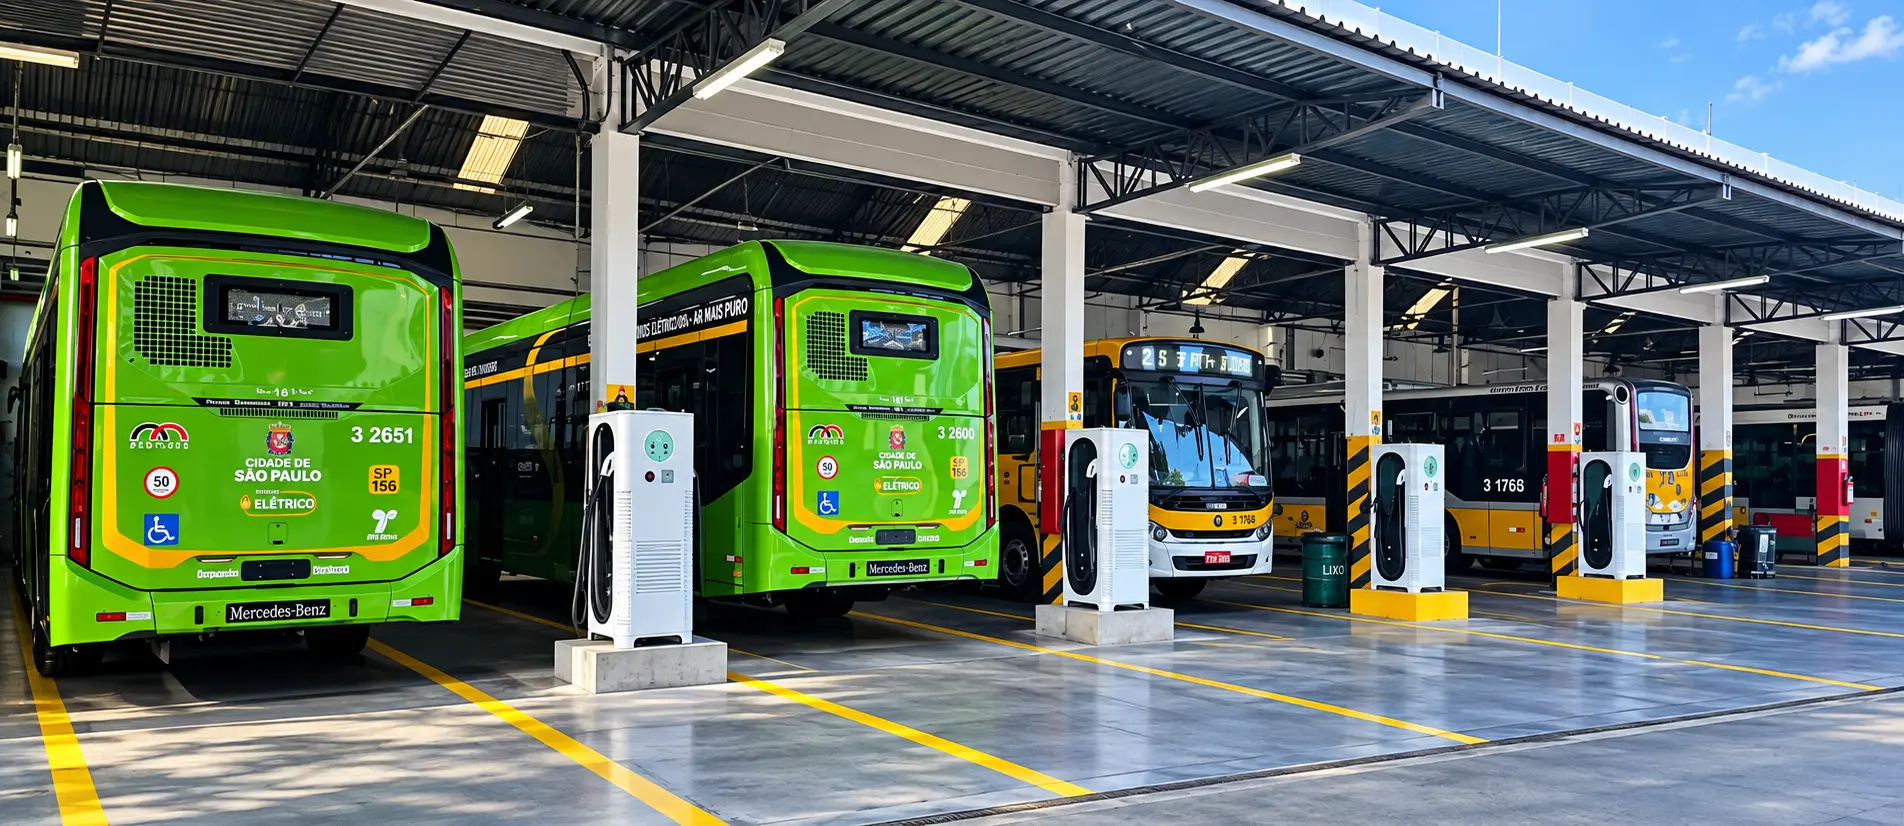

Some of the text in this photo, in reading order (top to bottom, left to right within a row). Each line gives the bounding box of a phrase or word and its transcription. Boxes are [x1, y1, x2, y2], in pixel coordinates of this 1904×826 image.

[693, 309, 703, 325] AR
[704, 303, 723, 323] MAIS
[724, 297, 748, 318] PURO
[351, 426, 414, 444] 3 2651
[937, 426, 975, 440] 3 2600
[906, 452, 916, 460] DE
[245, 458, 311, 468] CIDADE DE
[873, 458, 922, 470] SÃO PAULO
[953, 458, 965, 467] SP
[234, 468, 322, 482] SÃO PAULO
[374, 467, 393, 479] SP
[952, 467, 967, 477] 156
[153, 475, 170, 488] 50
[371, 480, 397, 492] 156
[1483, 478, 1491, 492] 3
[869, 561, 928, 574] Mercedes-Benz
[1322, 565, 1345, 576] LIXO
[229, 602, 327, 621] Mercedes-Benz
